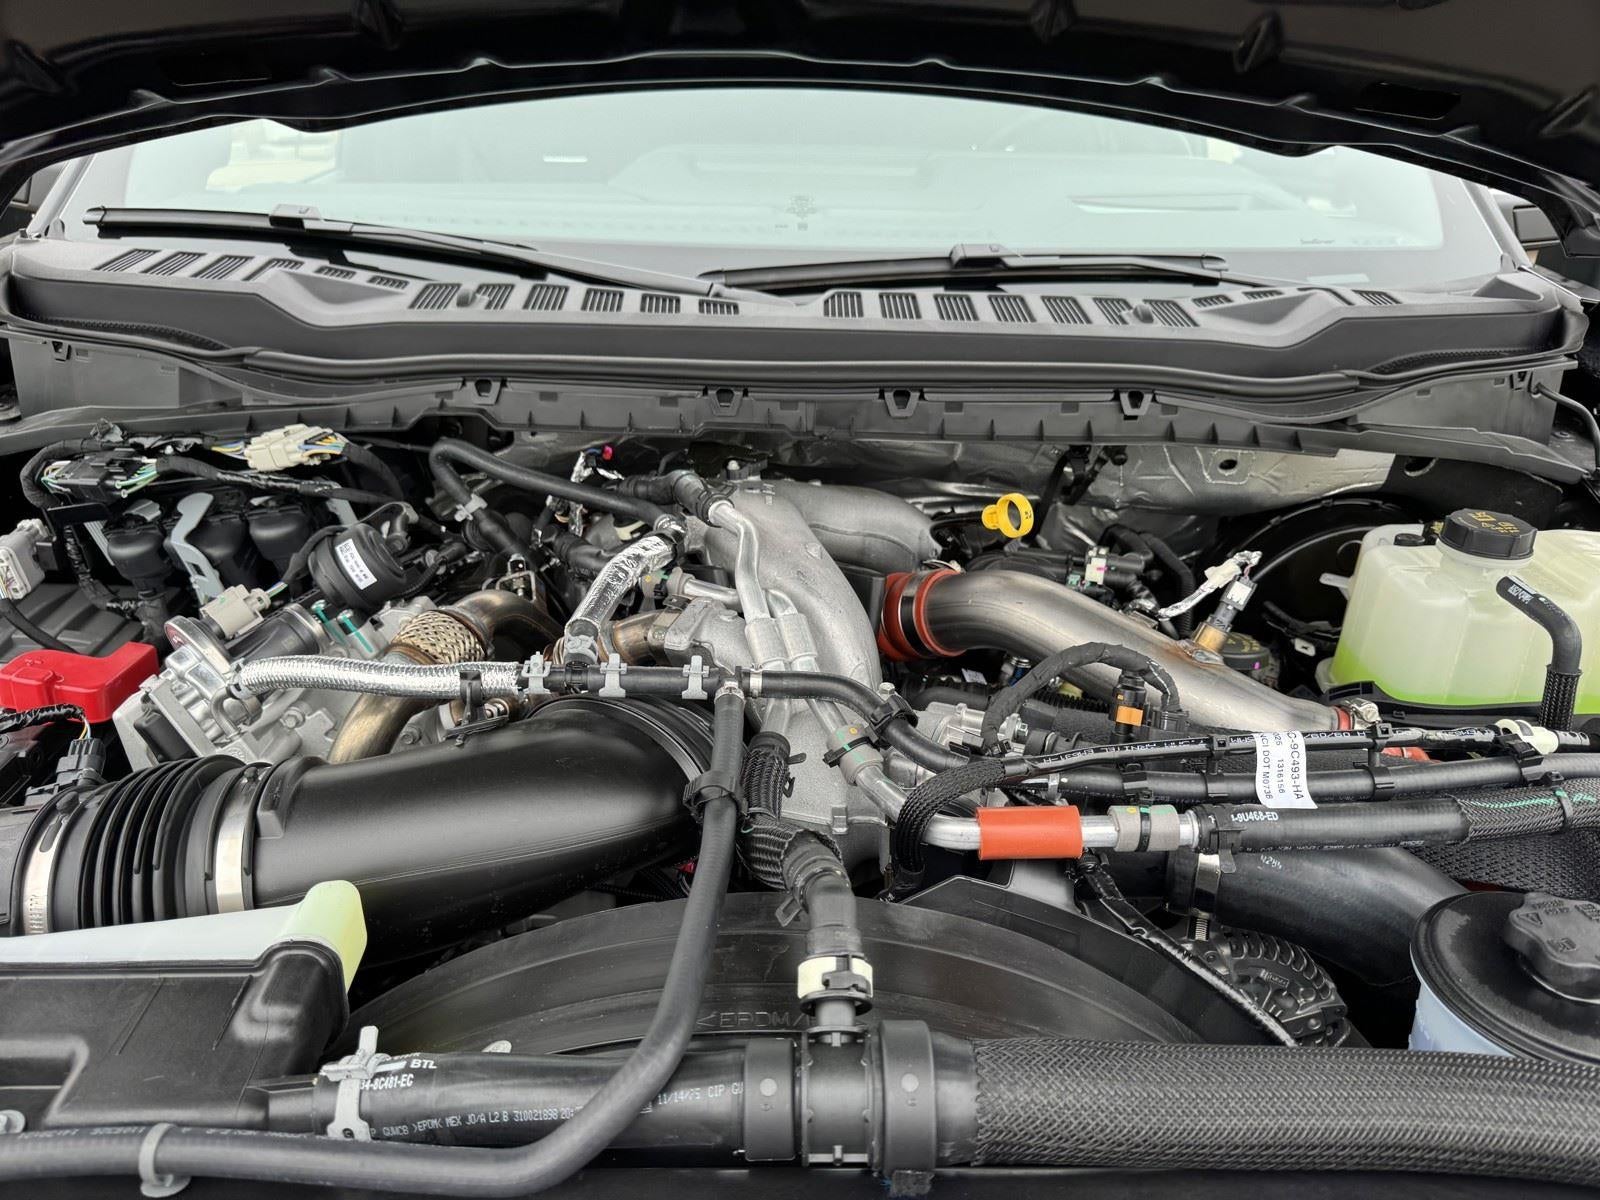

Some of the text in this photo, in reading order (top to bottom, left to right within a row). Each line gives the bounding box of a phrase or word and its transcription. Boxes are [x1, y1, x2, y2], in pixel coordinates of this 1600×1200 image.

[1263, 750, 1271, 768] DOT
[410, 1058, 438, 1069] BTL
[445, 1115, 462, 1128] MEX
[488, 1110, 500, 1123] L2
[707, 1084, 725, 1098] CIP
